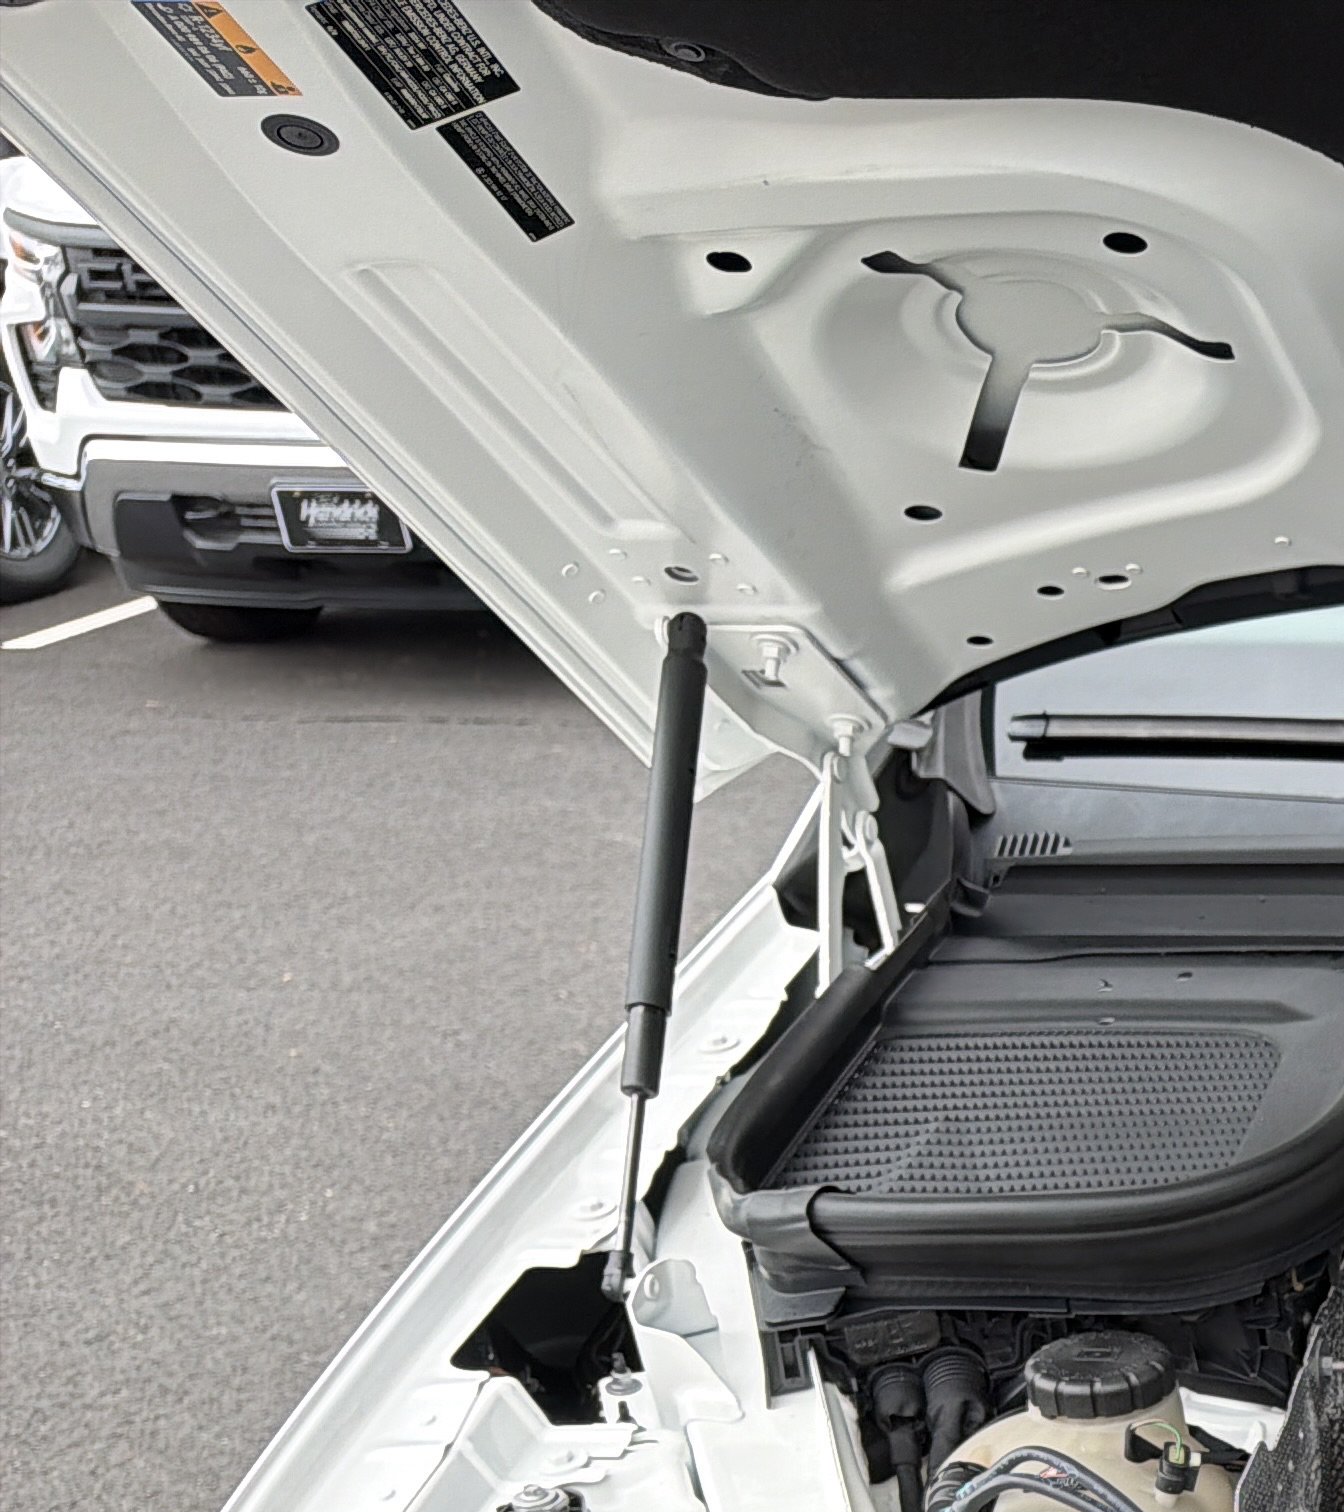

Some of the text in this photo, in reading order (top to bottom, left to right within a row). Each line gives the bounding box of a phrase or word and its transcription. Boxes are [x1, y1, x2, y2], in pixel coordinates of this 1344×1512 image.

[183, 15, 232, 51] R-1234yf
[399, 5, 432, 36] EMISSION
[423, 34, 454, 64] CONTROL
[446, 63, 487, 103] INFORMATION
[406, 0, 454, 44] ERCEDES-BENZ
[453, 53, 486, 84] GERMANY
[431, 9, 456, 32] UNDER
[448, 31, 482, 64] CONTRACT
[475, 62, 492, 76] FOR
